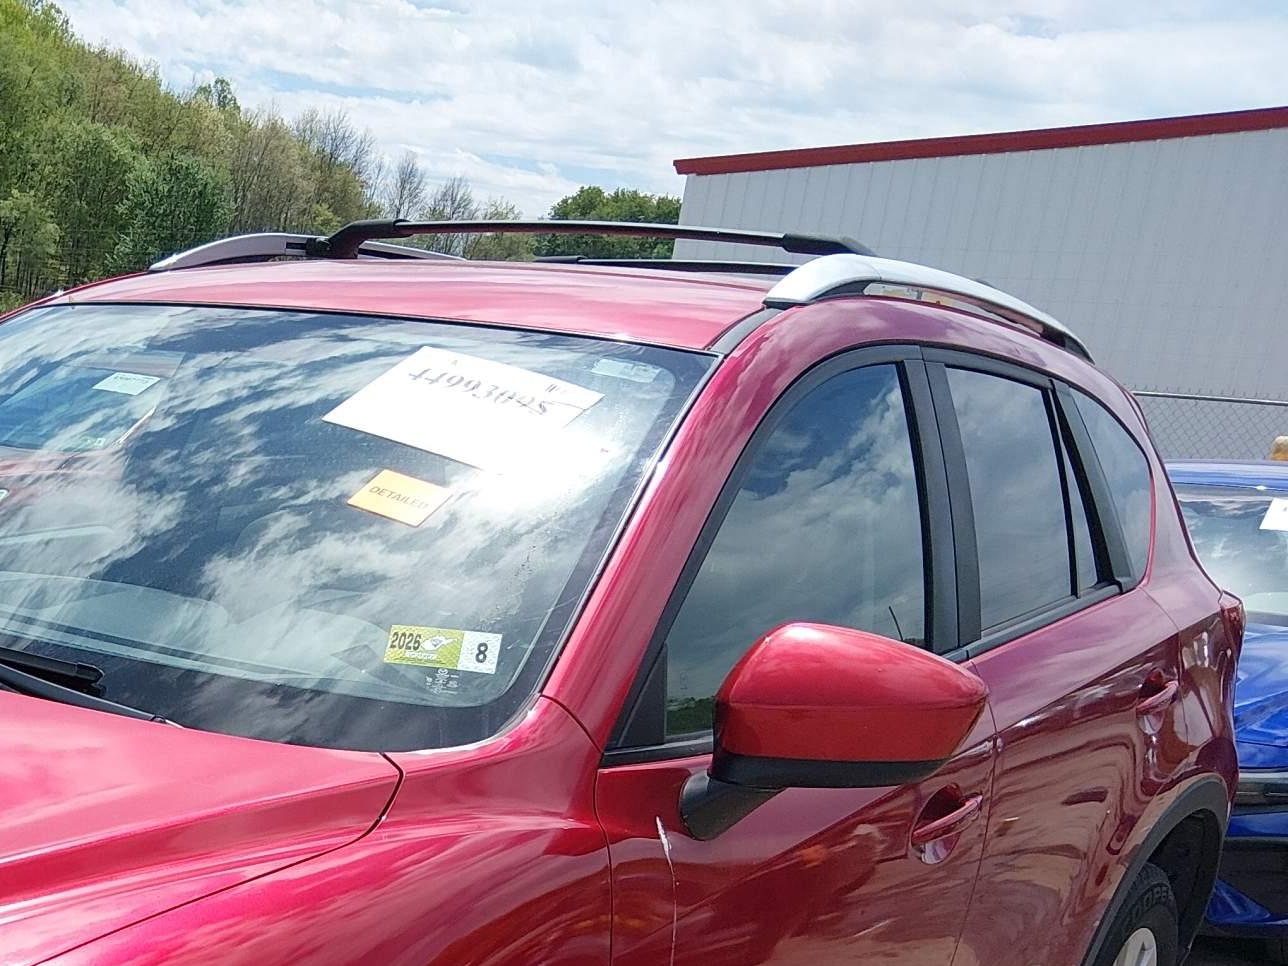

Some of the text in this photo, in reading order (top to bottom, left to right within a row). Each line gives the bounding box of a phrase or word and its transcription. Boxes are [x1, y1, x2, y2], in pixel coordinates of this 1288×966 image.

[368, 486, 429, 510] DETAILED
[390, 631, 422, 651] 2026
[475, 642, 489, 663] 8
